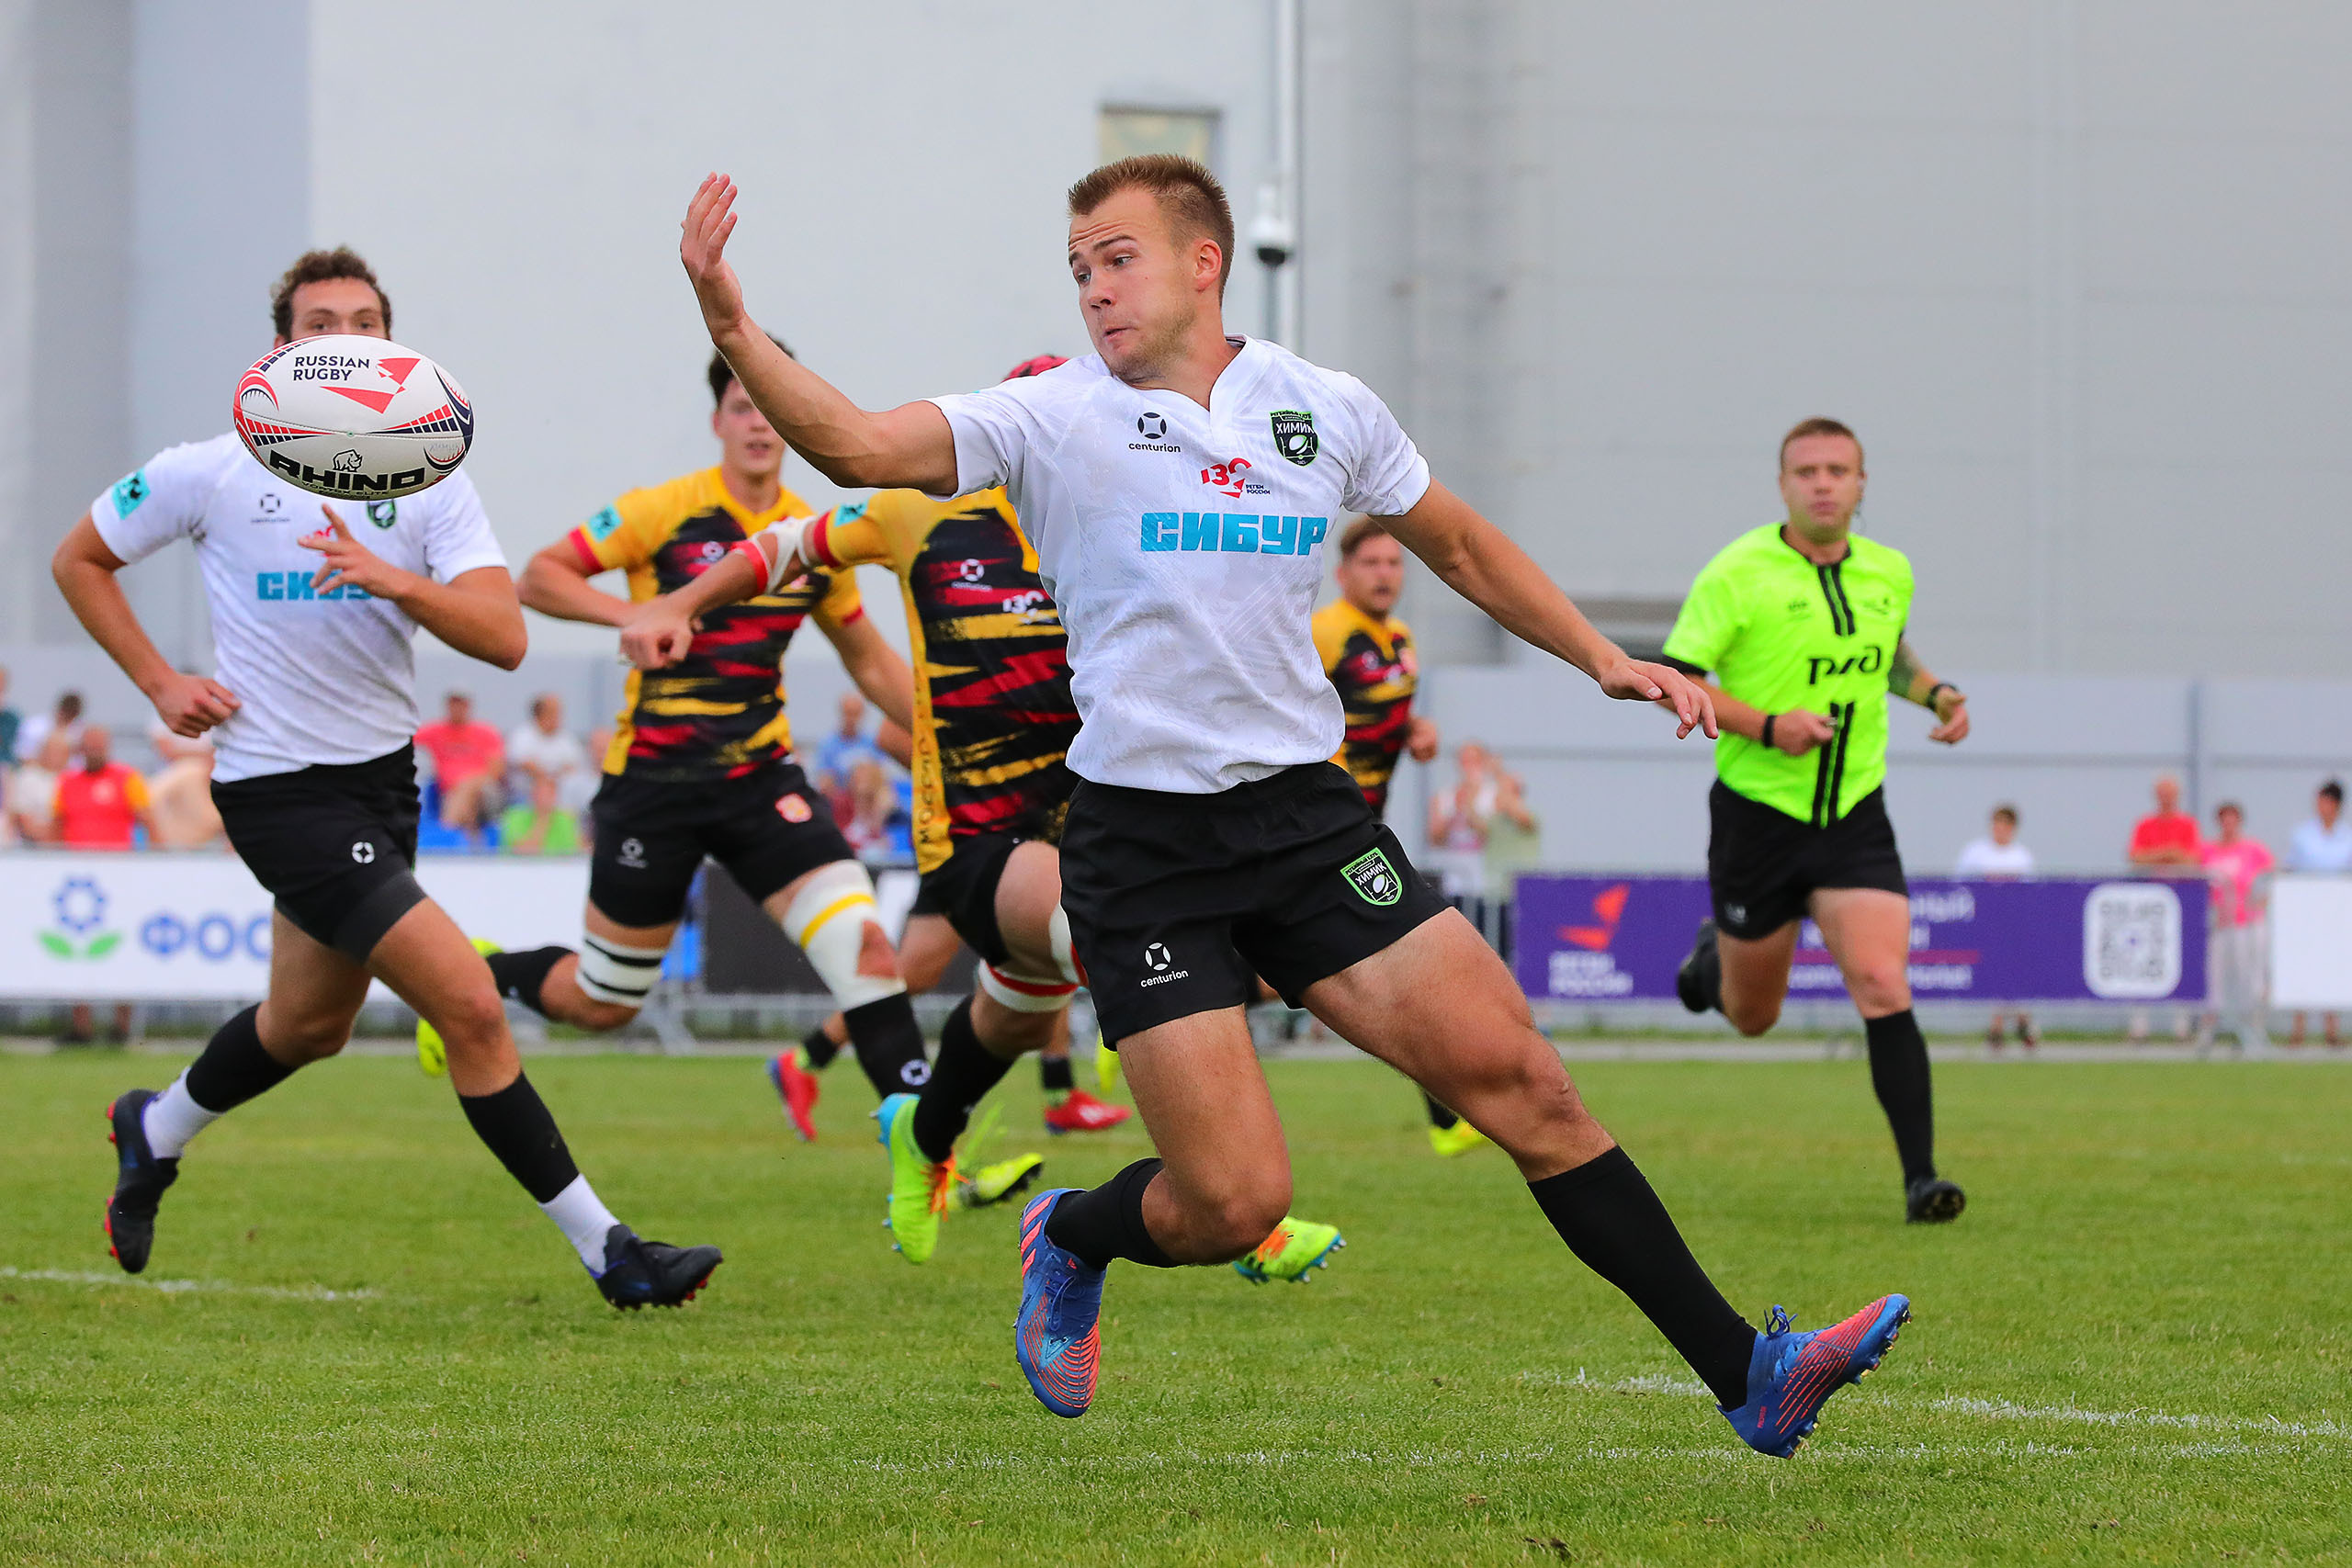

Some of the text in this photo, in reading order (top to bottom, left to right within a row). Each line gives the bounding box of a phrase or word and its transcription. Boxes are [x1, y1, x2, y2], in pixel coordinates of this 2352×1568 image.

[294, 355, 370, 369] RUSSIAN
[293, 368, 353, 381] RUGBY
[1128, 442, 1182, 453] centurion
[269, 449, 425, 491] RHINO
[1140, 512, 1329, 556] СИБУР
[256, 570, 372, 601] СИБ
[1354, 861, 1387, 886] ХИМИК
[1140, 970, 1189, 987] centurion
